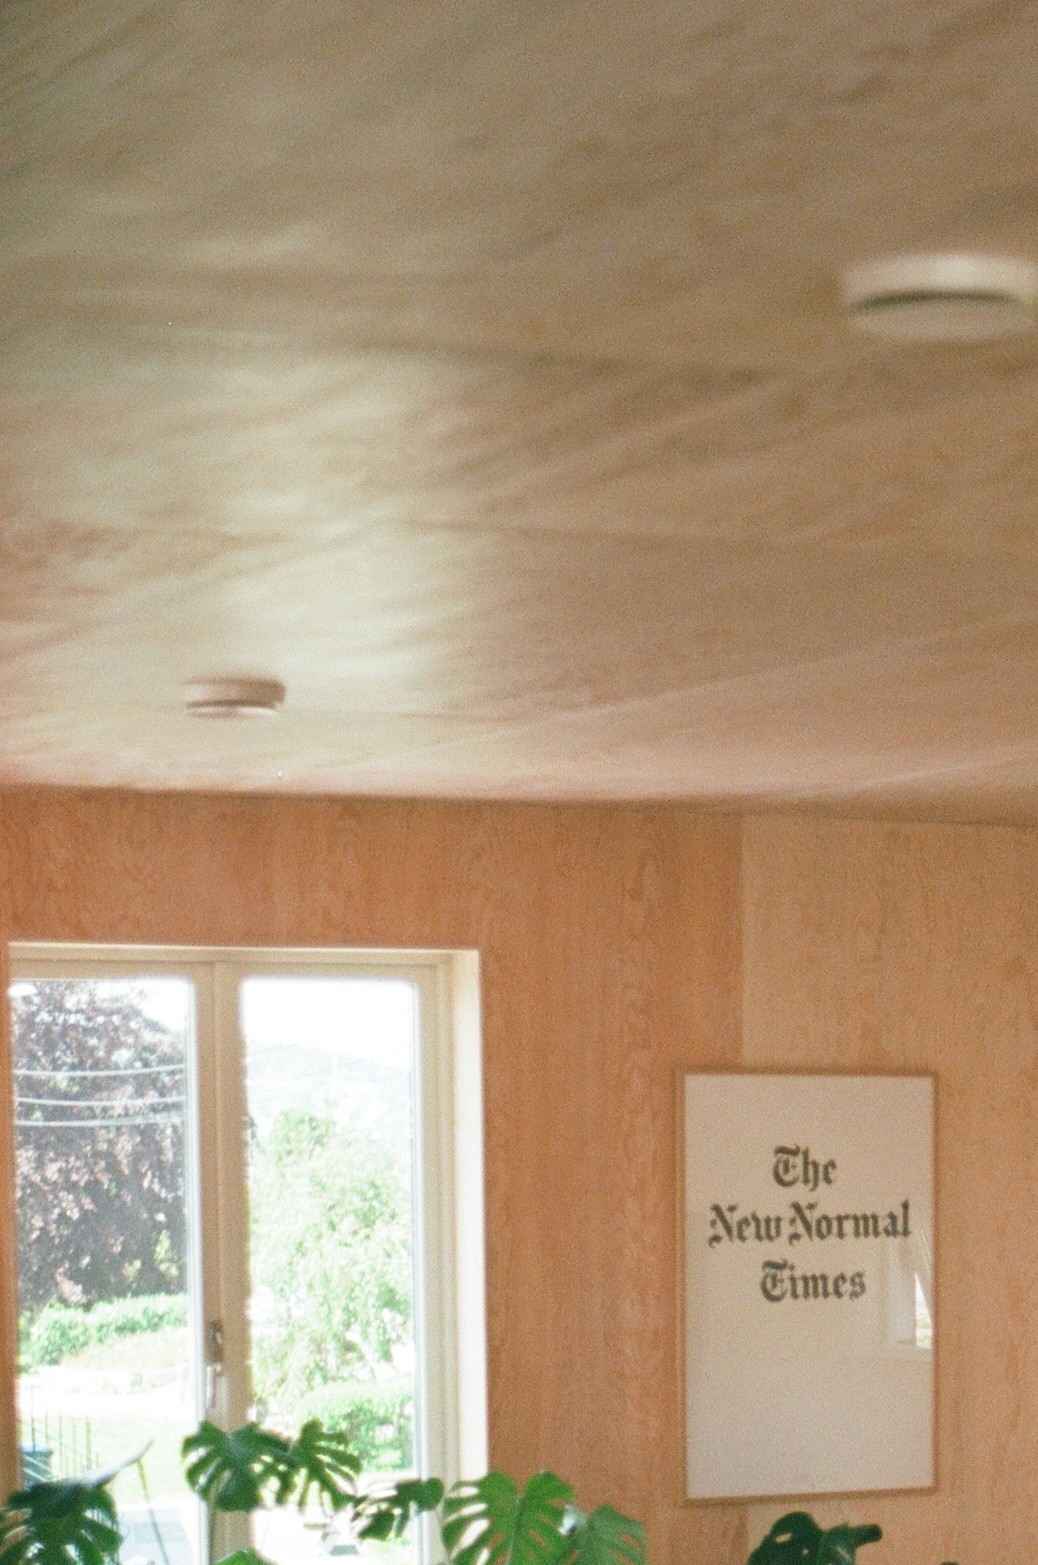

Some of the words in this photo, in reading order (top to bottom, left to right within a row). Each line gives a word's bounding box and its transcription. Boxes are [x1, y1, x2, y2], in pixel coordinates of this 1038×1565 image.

[772, 1145, 837, 1191] The
[708, 1203, 784, 1248] New
[787, 1199, 911, 1246] Normal
[760, 1259, 866, 1303] Times
